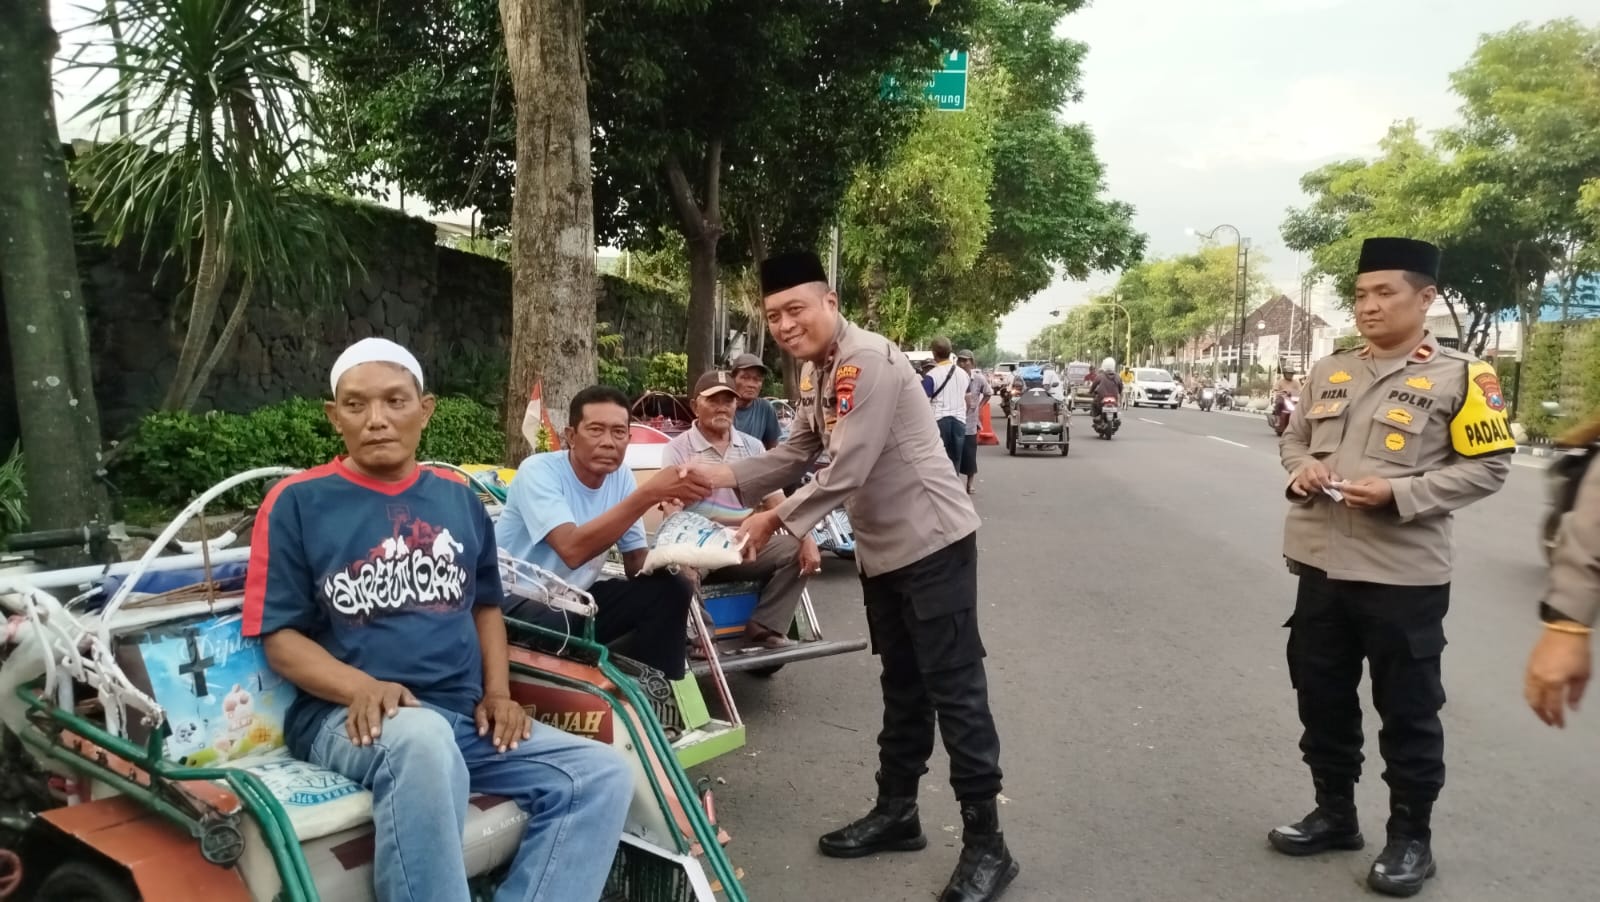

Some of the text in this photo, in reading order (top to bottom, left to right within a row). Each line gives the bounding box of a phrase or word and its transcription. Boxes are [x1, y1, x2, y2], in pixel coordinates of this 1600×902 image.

[1321, 388, 1348, 400] RIZAL
[1388, 390, 1434, 409] POLRI
[540, 711, 606, 733] GAJAH
